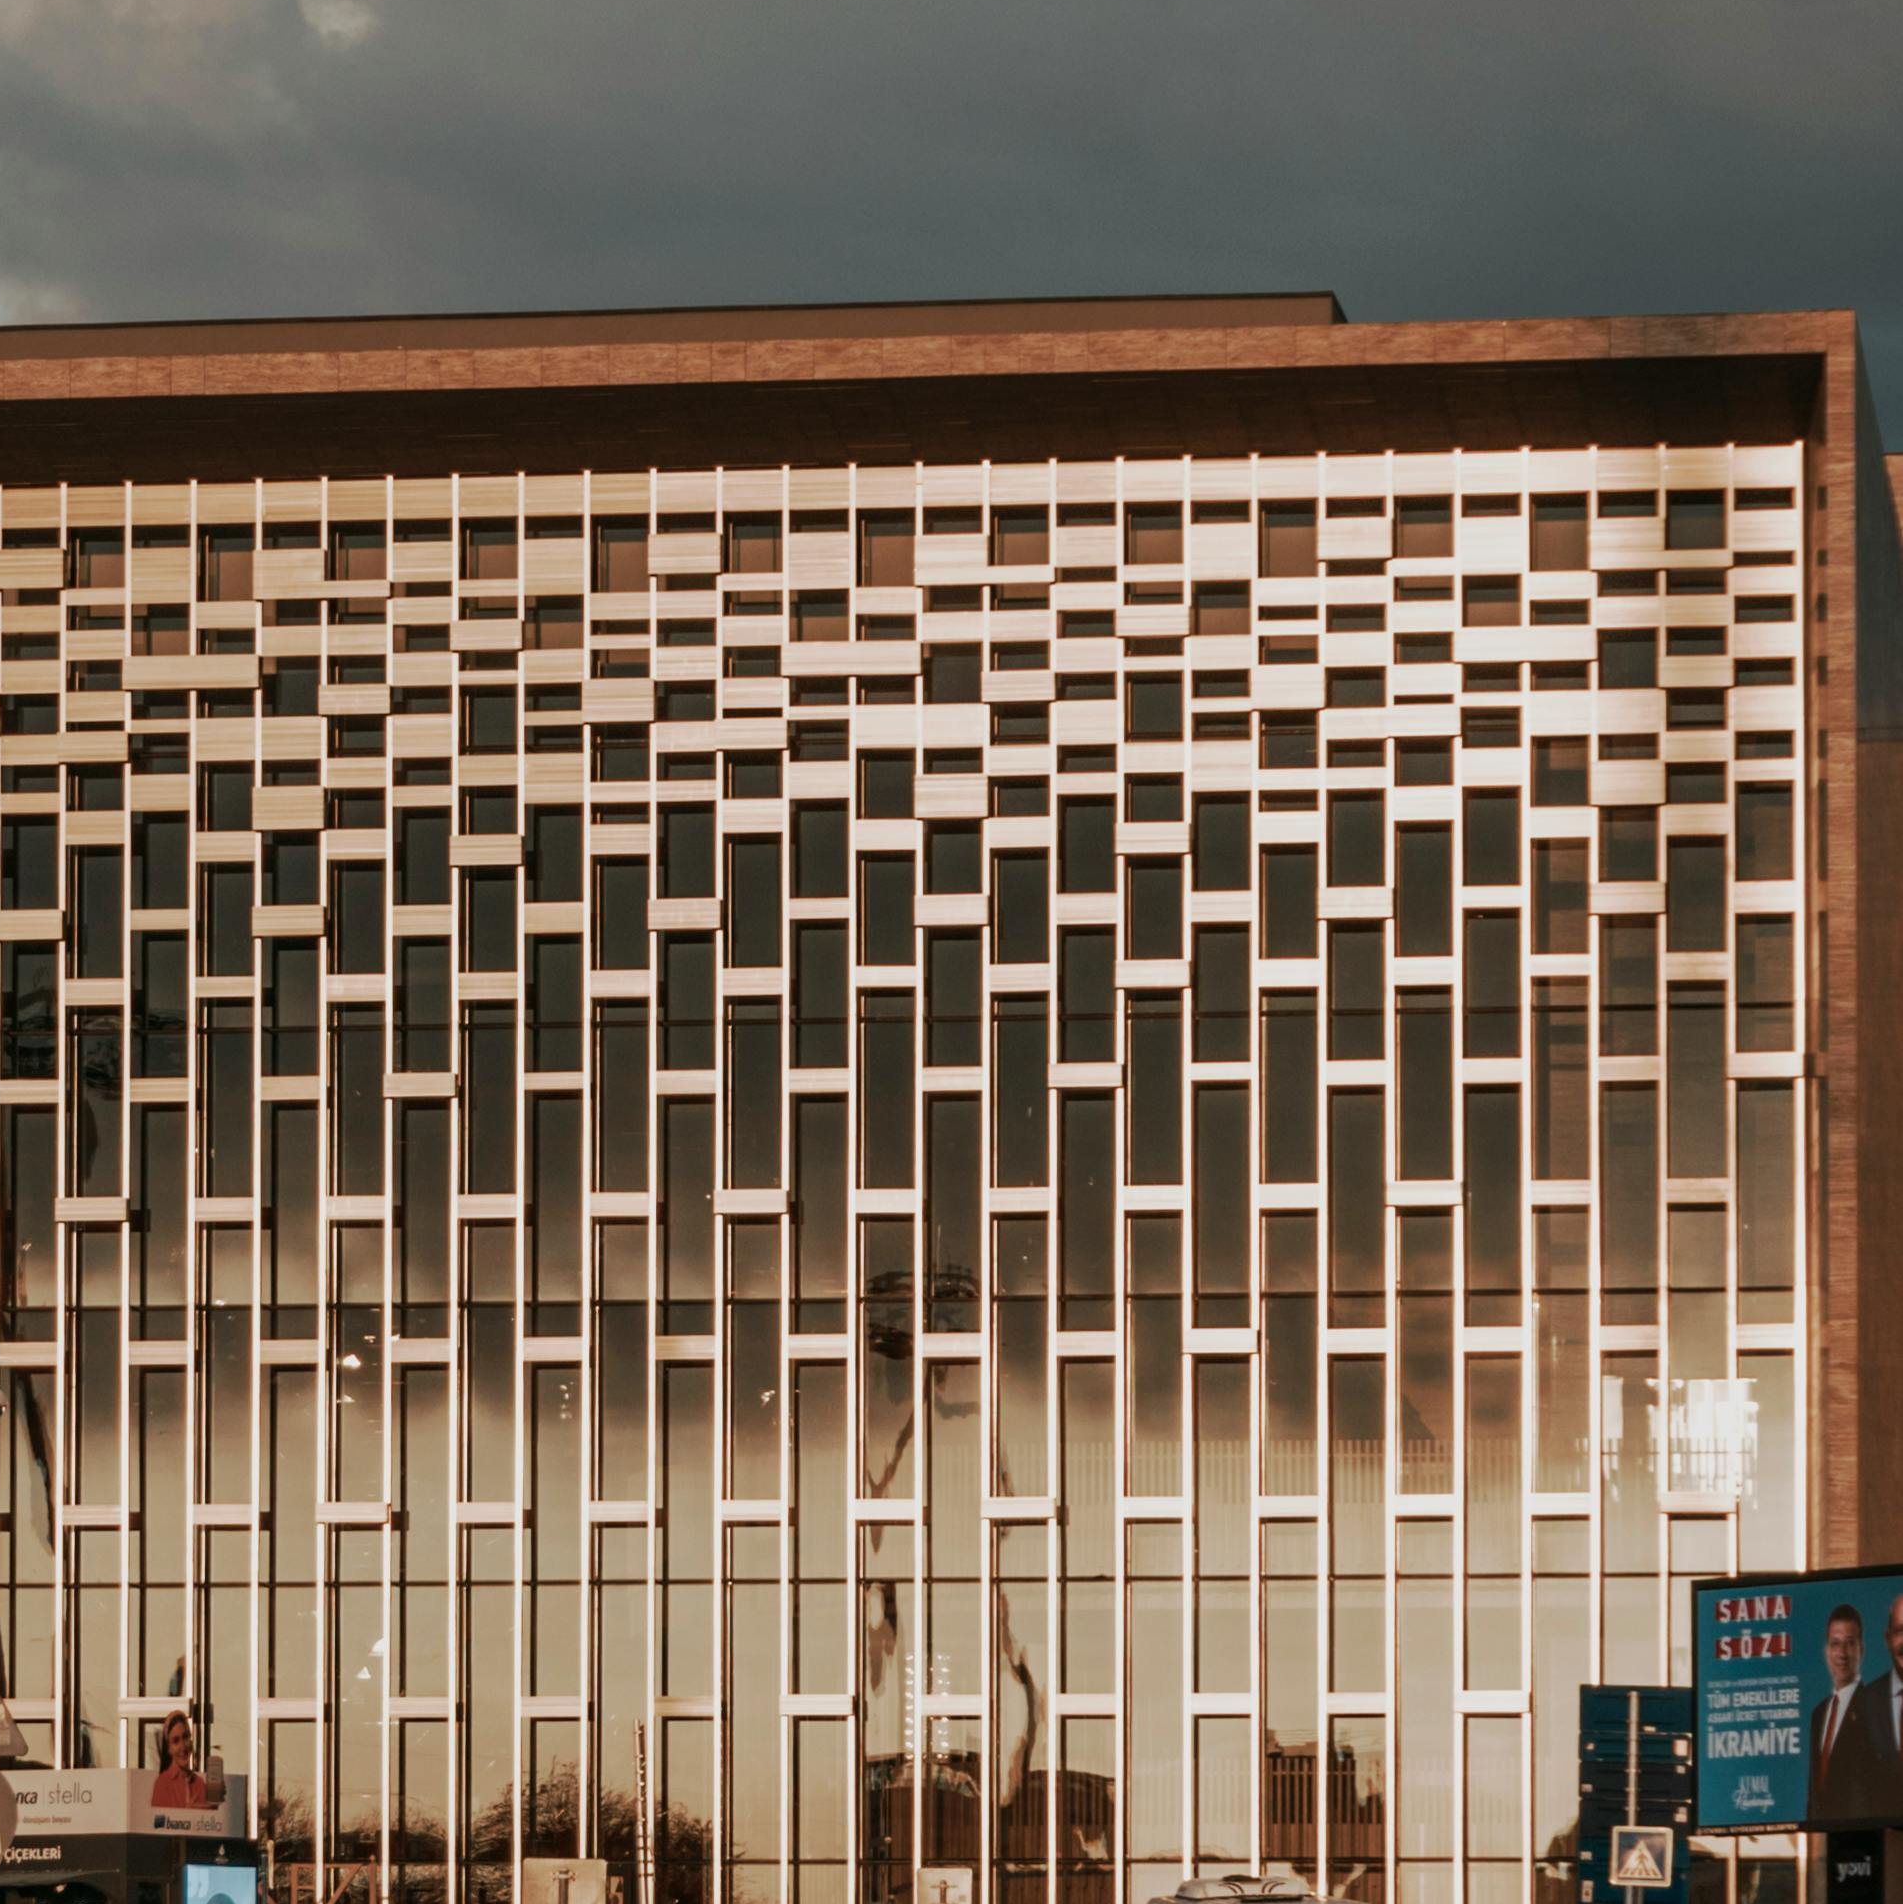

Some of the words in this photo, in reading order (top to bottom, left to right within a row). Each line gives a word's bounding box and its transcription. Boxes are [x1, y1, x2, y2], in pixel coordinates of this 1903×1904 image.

[1719, 1595, 1787, 1623] SANA
[1719, 1629, 1787, 1661] SÖZ!
[1707, 1690, 1731, 1709] TÜM
[1733, 1687, 1800, 1708] EMEKLİLERE
[1707, 1722, 1801, 1759] İKRAMİYE
[48, 1780, 93, 1805] stella
[166, 1816, 192, 1830] bianca
[4, 1845, 62, 1863] ÇİÇEKLERİ
